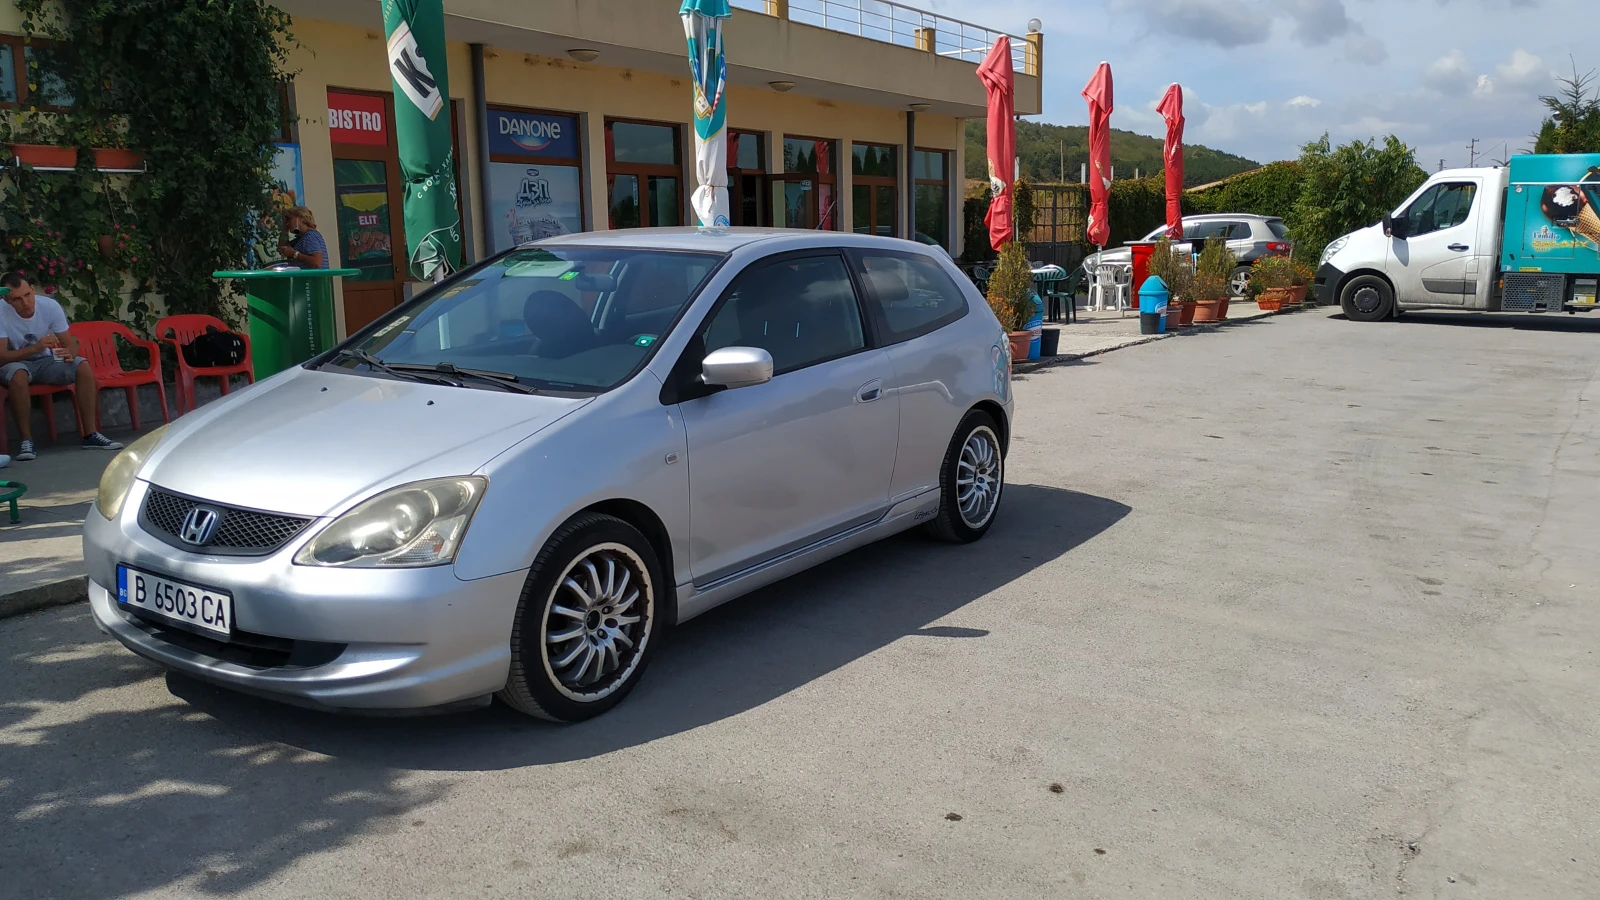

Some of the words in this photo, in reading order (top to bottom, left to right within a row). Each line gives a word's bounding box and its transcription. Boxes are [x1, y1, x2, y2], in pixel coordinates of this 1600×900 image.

[328, 108, 382, 132] BISTRO
[518, 179, 551, 201] ДЗП
[119, 588, 127, 598] BG
[135, 575, 147, 603] B
[155, 582, 198, 619] 6503
[201, 596, 226, 629] CA
